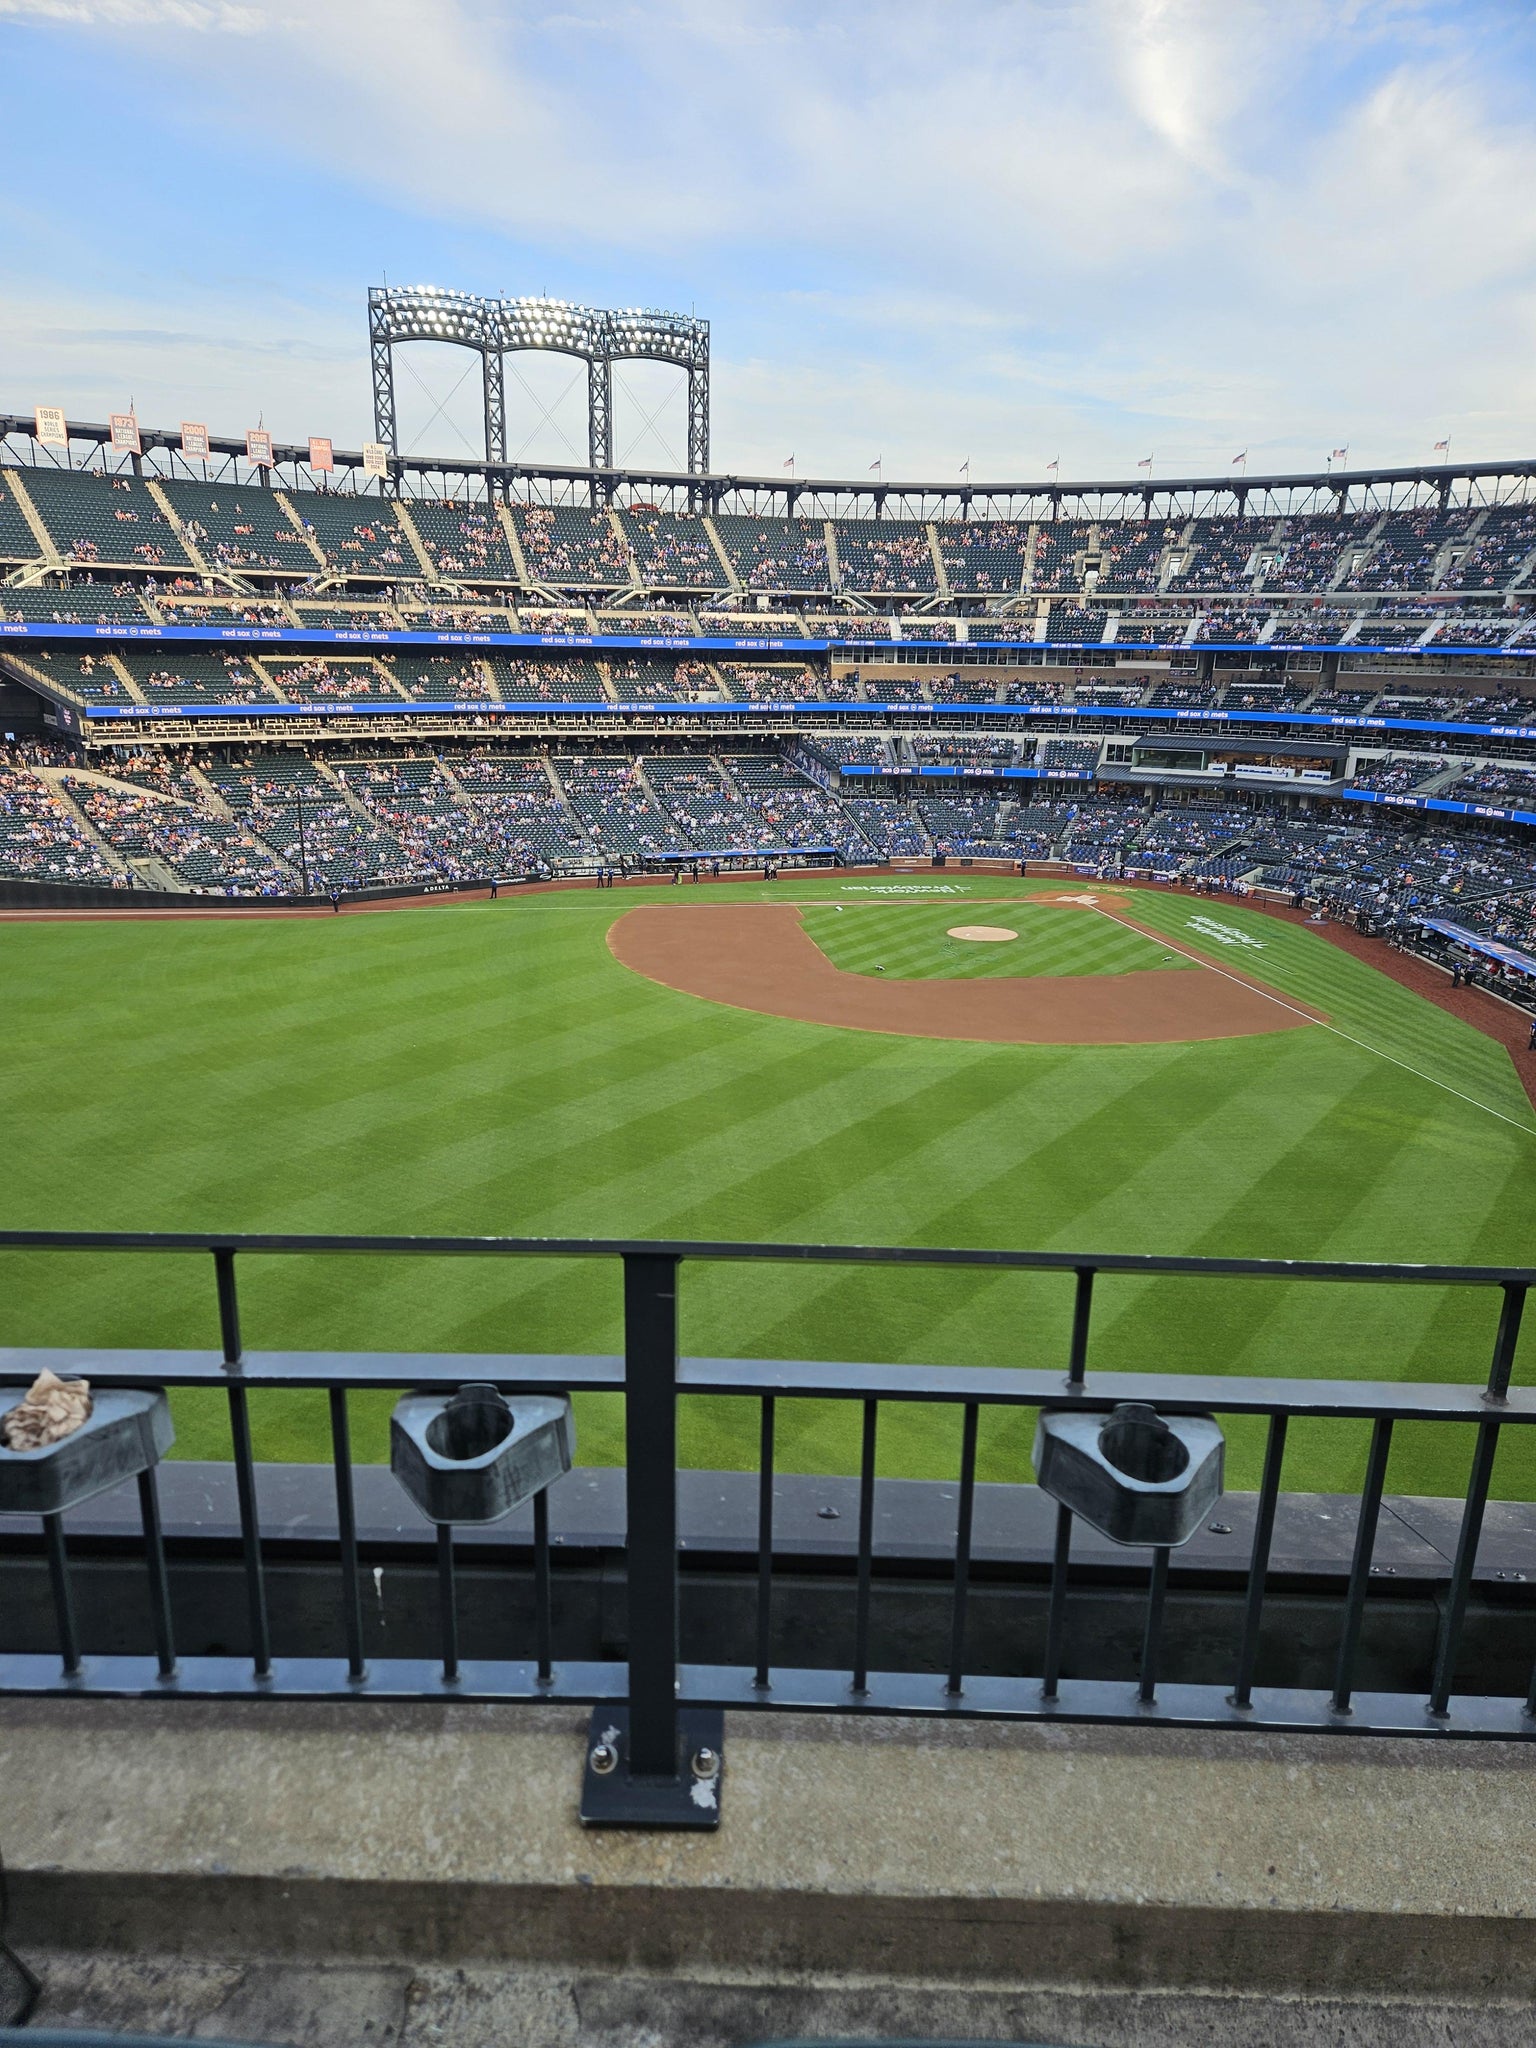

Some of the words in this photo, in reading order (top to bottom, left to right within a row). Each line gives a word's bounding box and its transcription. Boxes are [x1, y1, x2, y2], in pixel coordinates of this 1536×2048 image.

[40, 410, 60, 420] 1986
[114, 417, 134, 428] 1973
[184, 425, 204, 435] 2000
